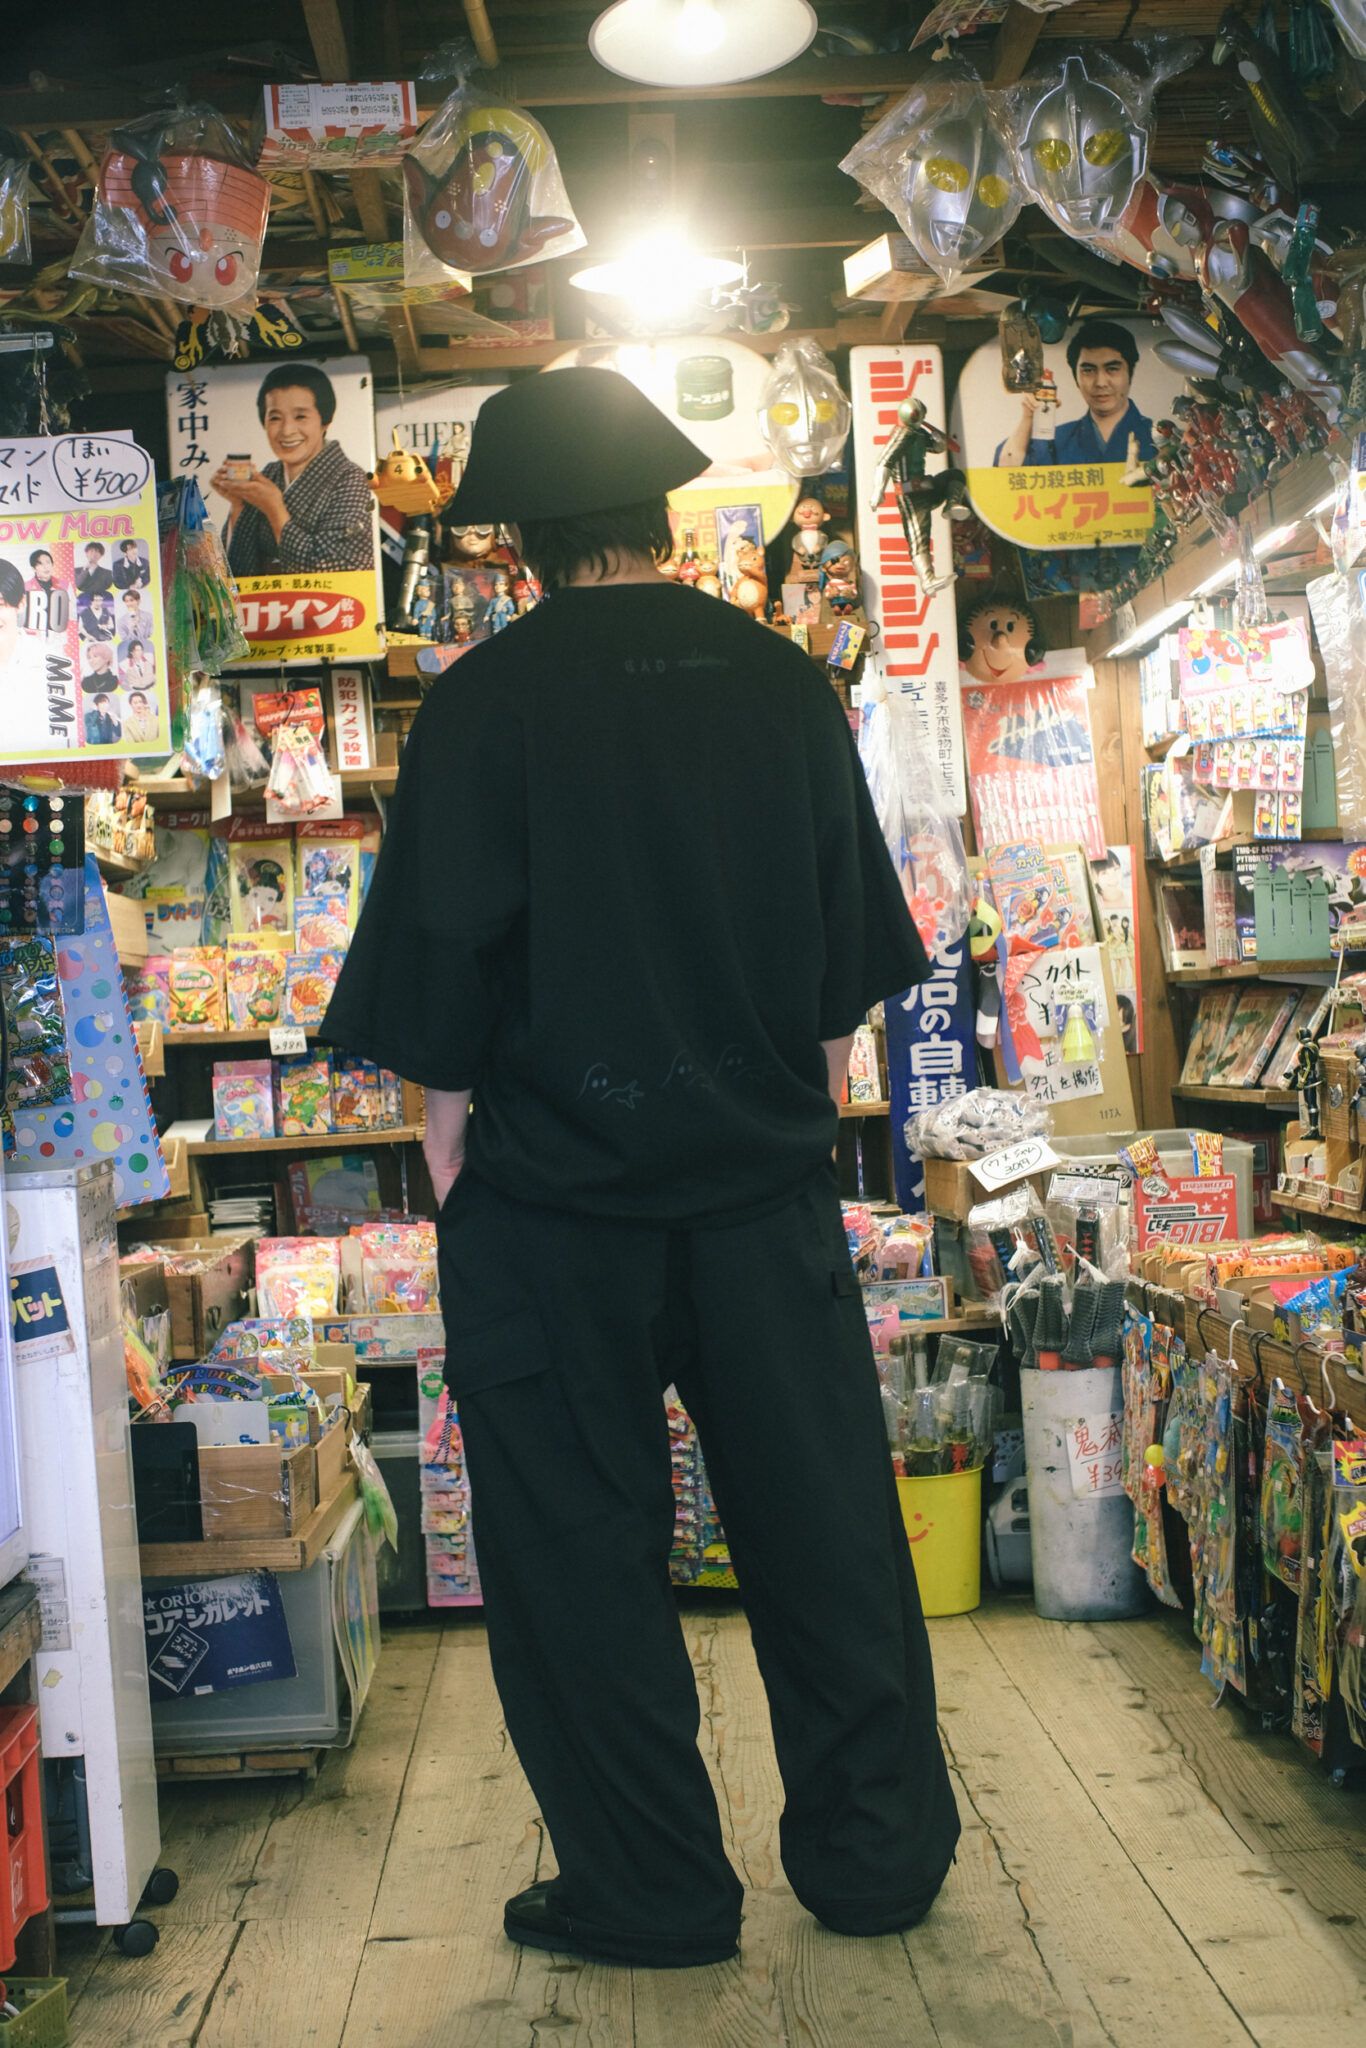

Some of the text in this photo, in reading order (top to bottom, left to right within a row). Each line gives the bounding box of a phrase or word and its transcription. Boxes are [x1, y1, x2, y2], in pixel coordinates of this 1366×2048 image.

[73, 466, 138, 497] ¥500
[1008, 467, 1104, 491] 強力殺虫剤
[1012, 491, 1150, 529] ハイアー
[58, 511, 135, 541] Man
[237, 598, 342, 635] ロナイン
[244, 643, 336, 660] グループ・大塚製薬
[337, 676, 362, 766] 防犯カメラ設置
[1087, 1460, 1123, 1489] ¥39
